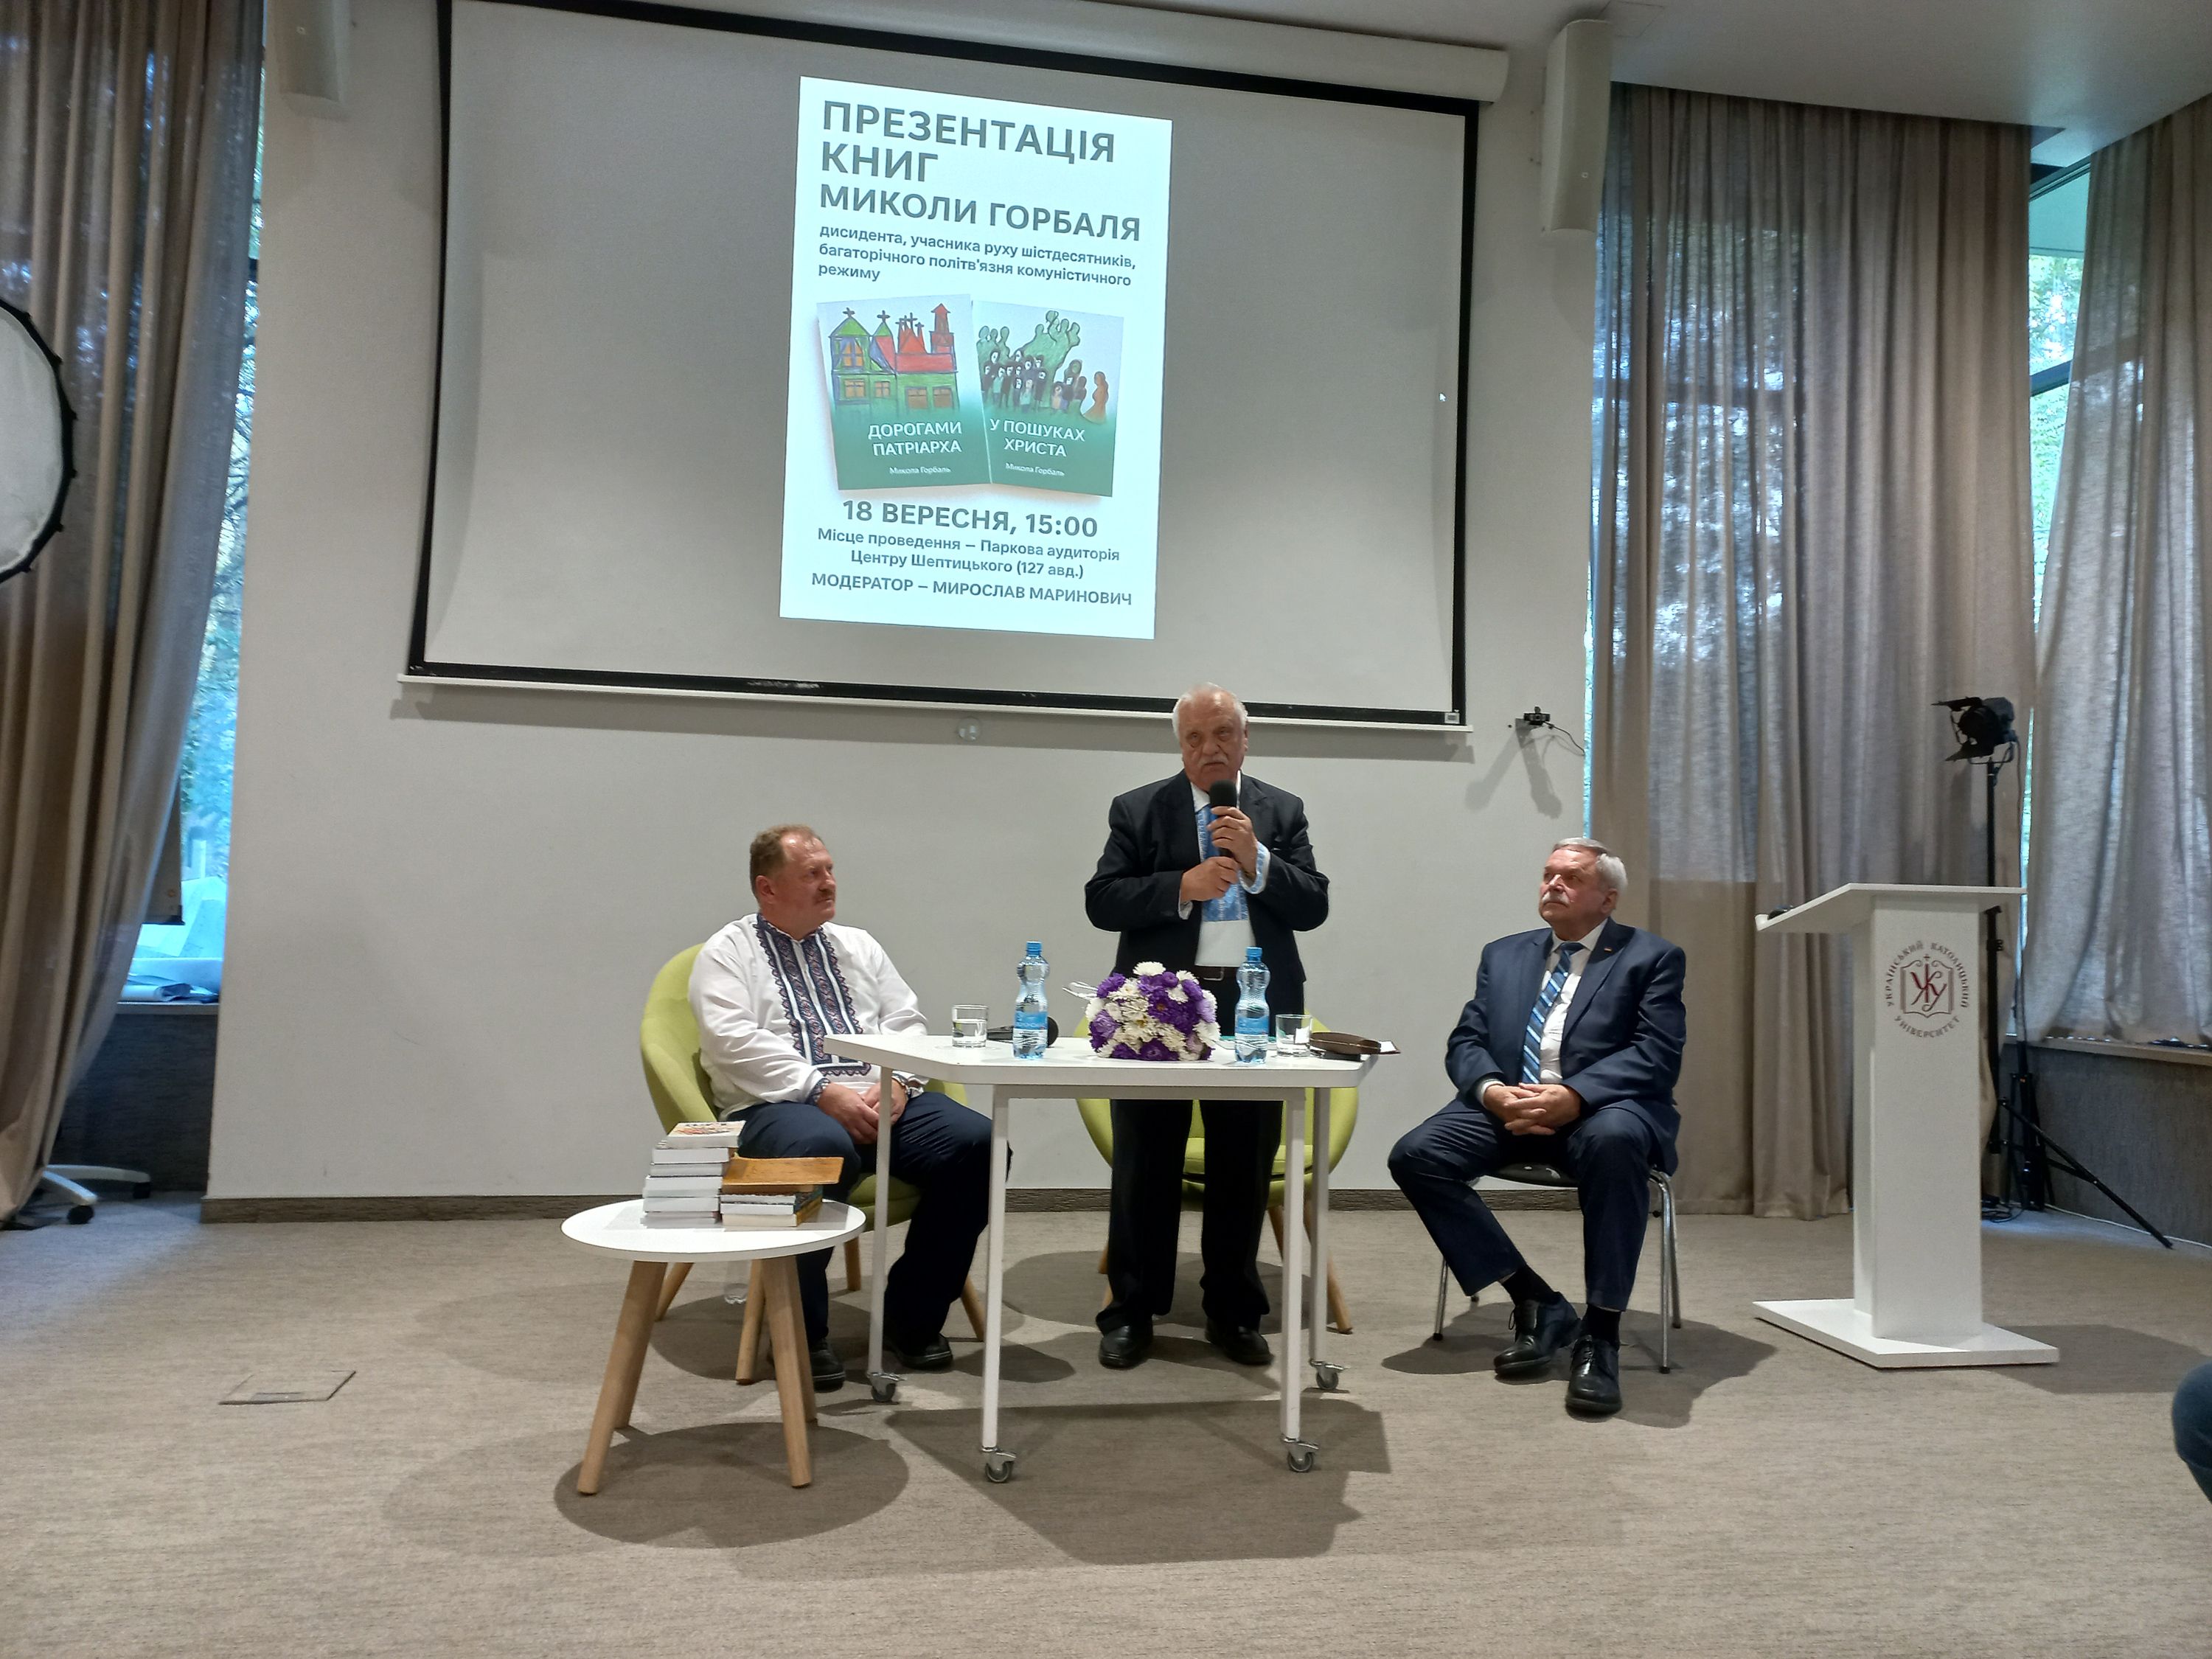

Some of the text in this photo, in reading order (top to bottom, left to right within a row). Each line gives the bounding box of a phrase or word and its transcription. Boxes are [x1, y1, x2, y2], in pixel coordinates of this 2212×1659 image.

[824, 100, 1113, 164] ПРЕЗЕНТАЦІЯ
[821, 142, 939, 182] КНИГ
[820, 184, 1141, 241] МИКОЛИ ГОРБАЛЯ
[820, 225, 1136, 270] дисидента, учасника руху шістдесятників,
[818, 265, 880, 282] режиму
[819, 244, 925, 267] багаторічного
[1017, 265, 1131, 286] комуністичного
[868, 422, 962, 439] ДОРОГАМИ
[990, 419, 1085, 442] У ПОШУКАХ
[873, 440, 962, 456] ПАТРІАРХА
[1004, 438, 1066, 457] ХРИСТА
[921, 466, 950, 474] Горбаль
[1006, 462, 1065, 476] Микола Горбаль
[843, 500, 1098, 537] 18 ВЕРЕСНЯ, 15:00
[818, 528, 864, 545] Місце
[868, 533, 961, 552] проведення
[981, 540, 1043, 557] Паркова
[1047, 547, 1119, 562] аудиторія
[851, 550, 1084, 579] Центру Шептицького (127 авд.)
[811, 573, 914, 592] МОДЕРАТОР
[933, 580, 1025, 599] МИРОСЛАВ
[1029, 587, 1132, 605] МАРИНОВИЧ
